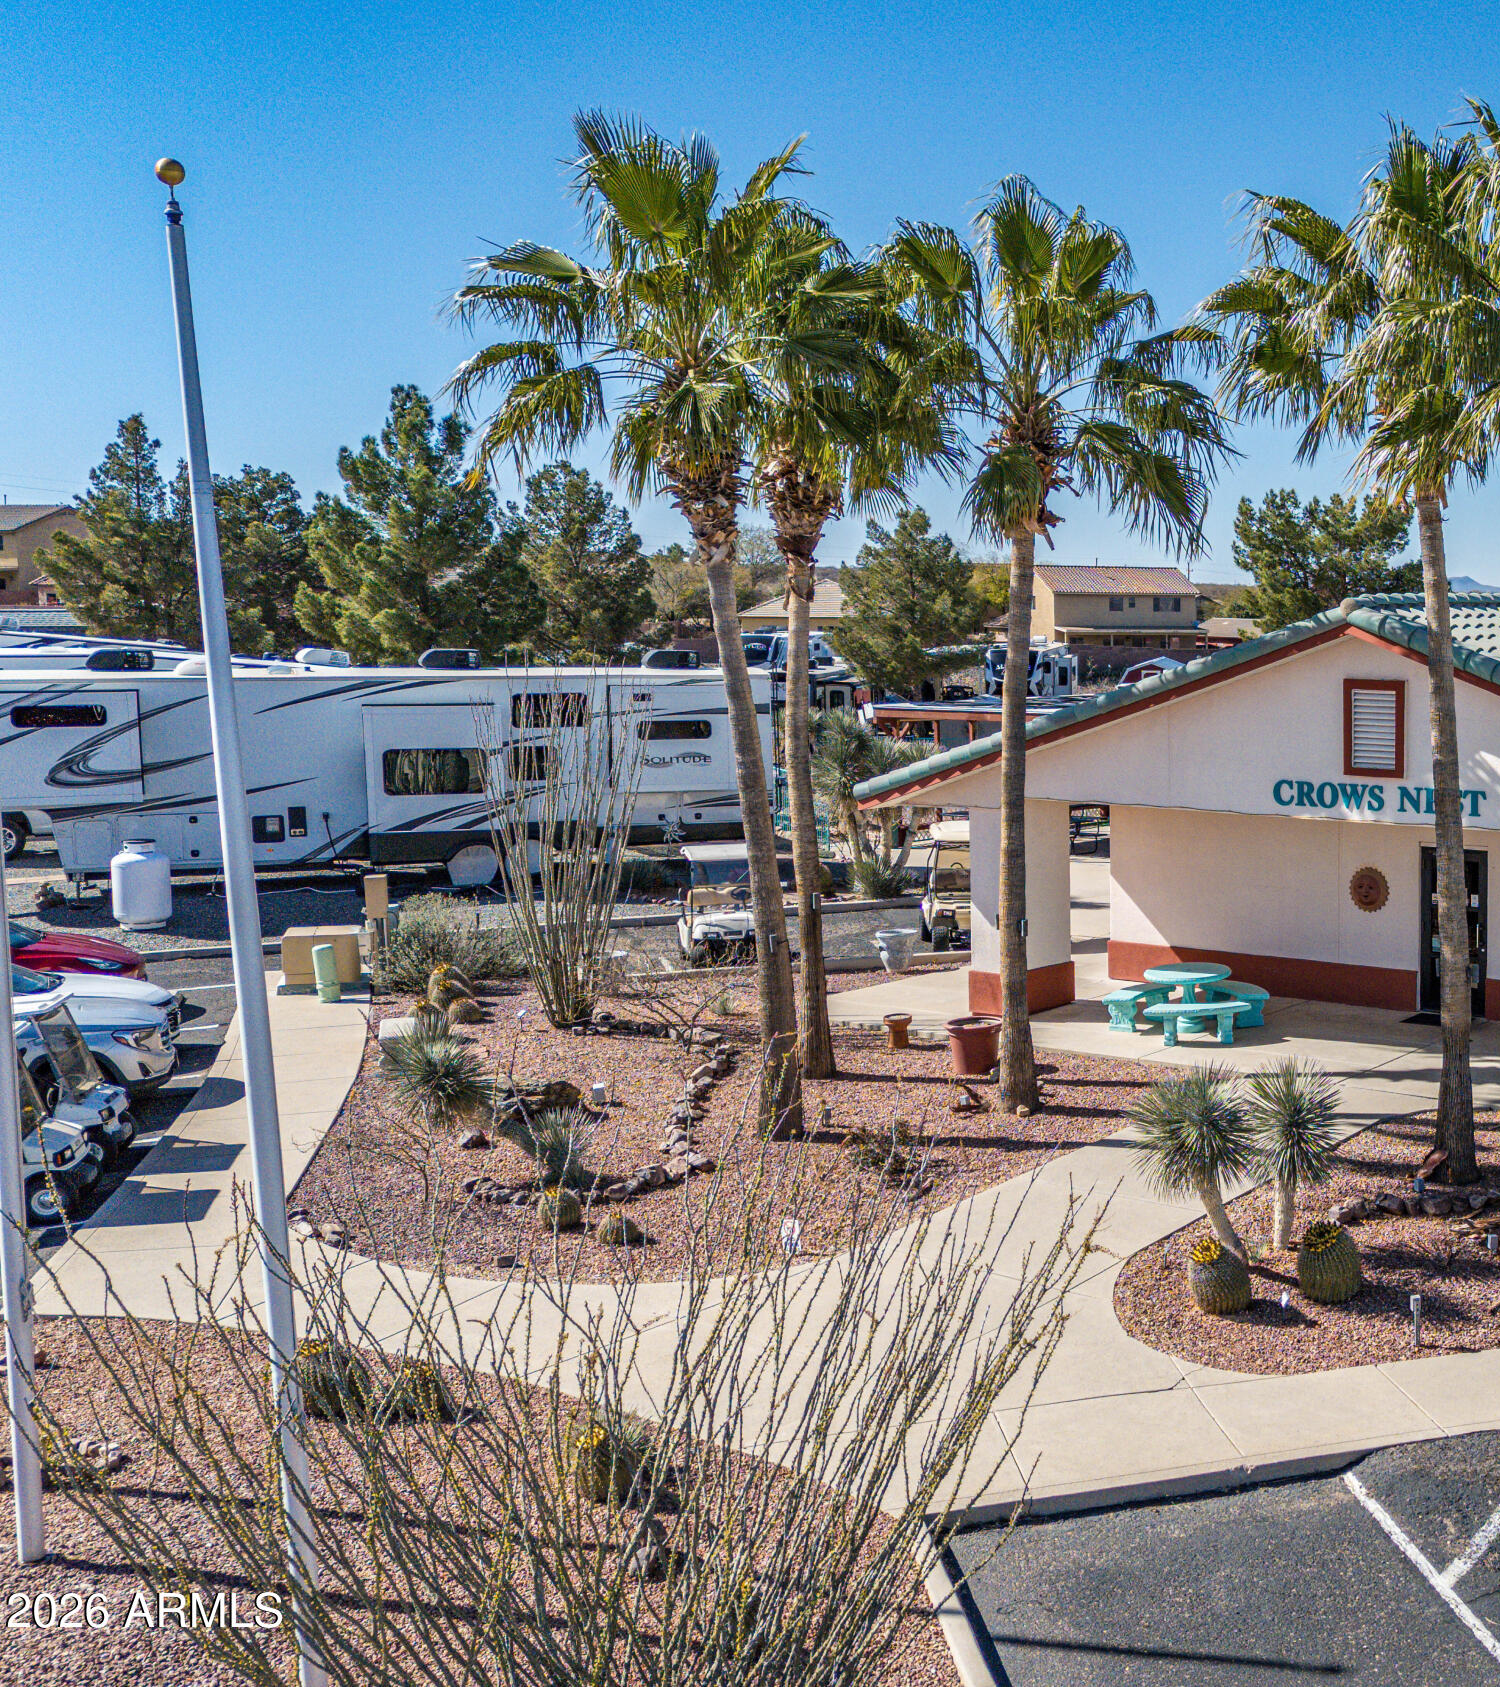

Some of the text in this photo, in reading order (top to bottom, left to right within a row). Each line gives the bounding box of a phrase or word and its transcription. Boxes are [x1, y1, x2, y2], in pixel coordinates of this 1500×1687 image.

[640, 755, 712, 765] SOLITUDE
[1273, 779, 1487, 817] CROWS NET
